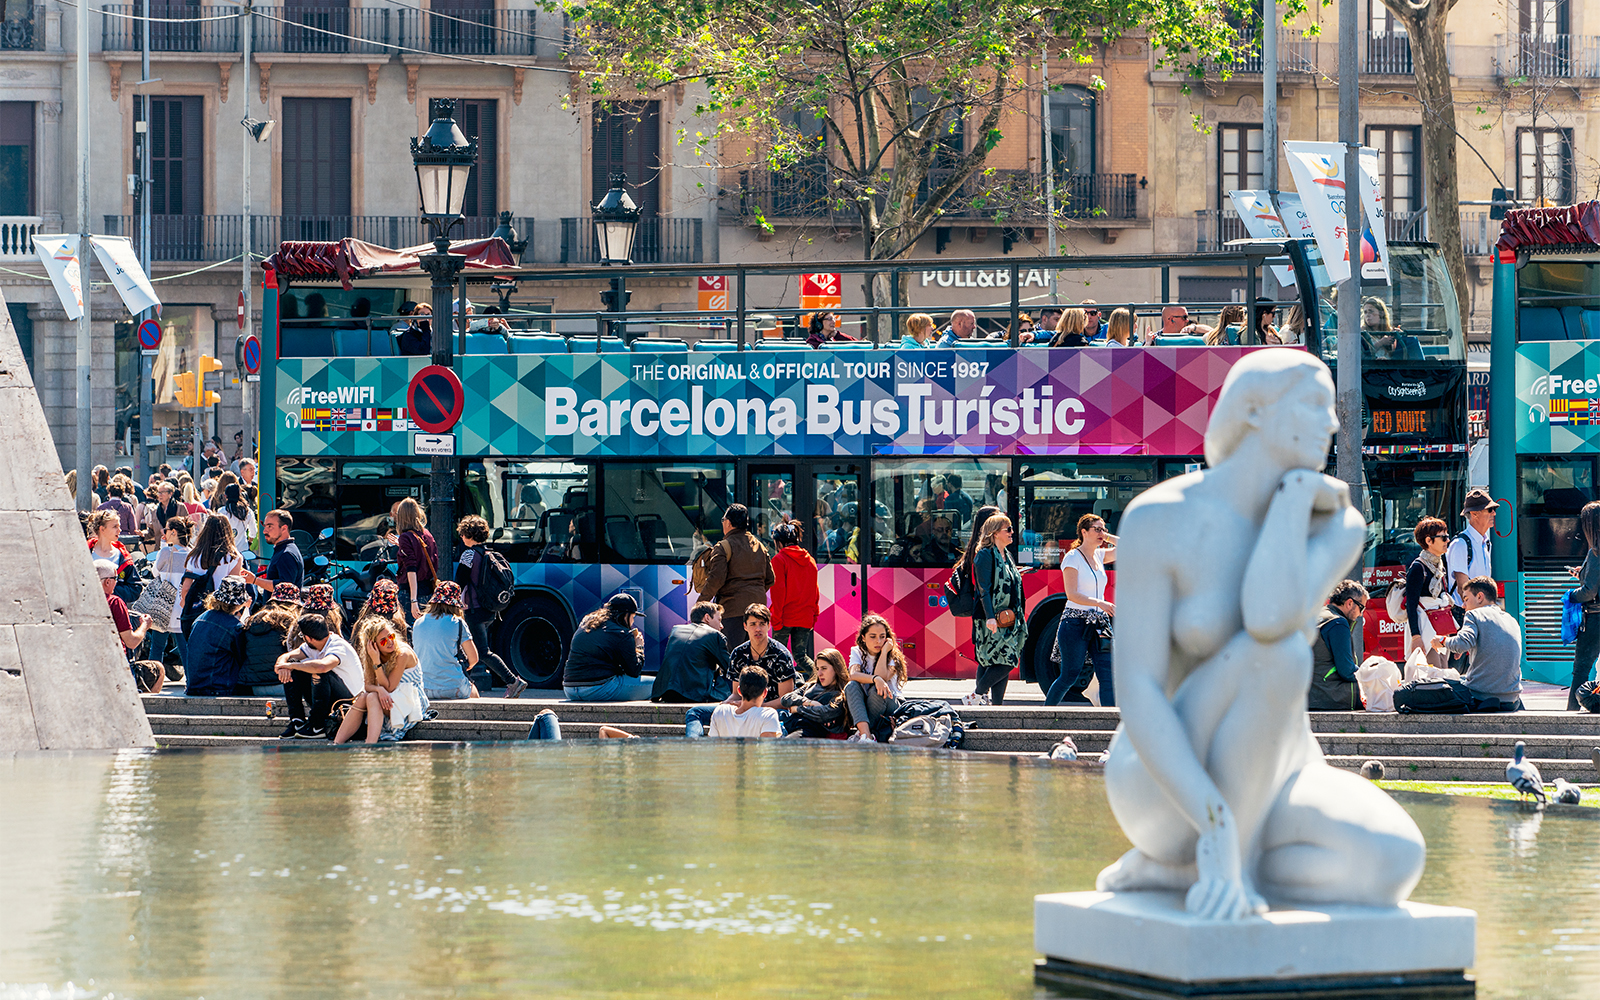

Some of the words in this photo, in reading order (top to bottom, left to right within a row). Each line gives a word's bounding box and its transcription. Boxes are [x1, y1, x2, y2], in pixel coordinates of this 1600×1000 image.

[633, 364, 664, 381] THE
[667, 363, 747, 381] ORIGINAL
[749, 363, 761, 380] &
[762, 362, 840, 380] OFFICIAL
[844, 361, 891, 379] TOUR
[896, 361, 947, 378] SINCE
[950, 361, 990, 378] 1987
[1549, 373, 1600, 394] Free
[301, 386, 375, 404] FreeWIFI
[545, 385, 798, 436] Barcelona
[1373, 411, 1392, 432] RED
[1396, 411, 1427, 432] ROUTE
[1376, 569, 1393, 578] Route
